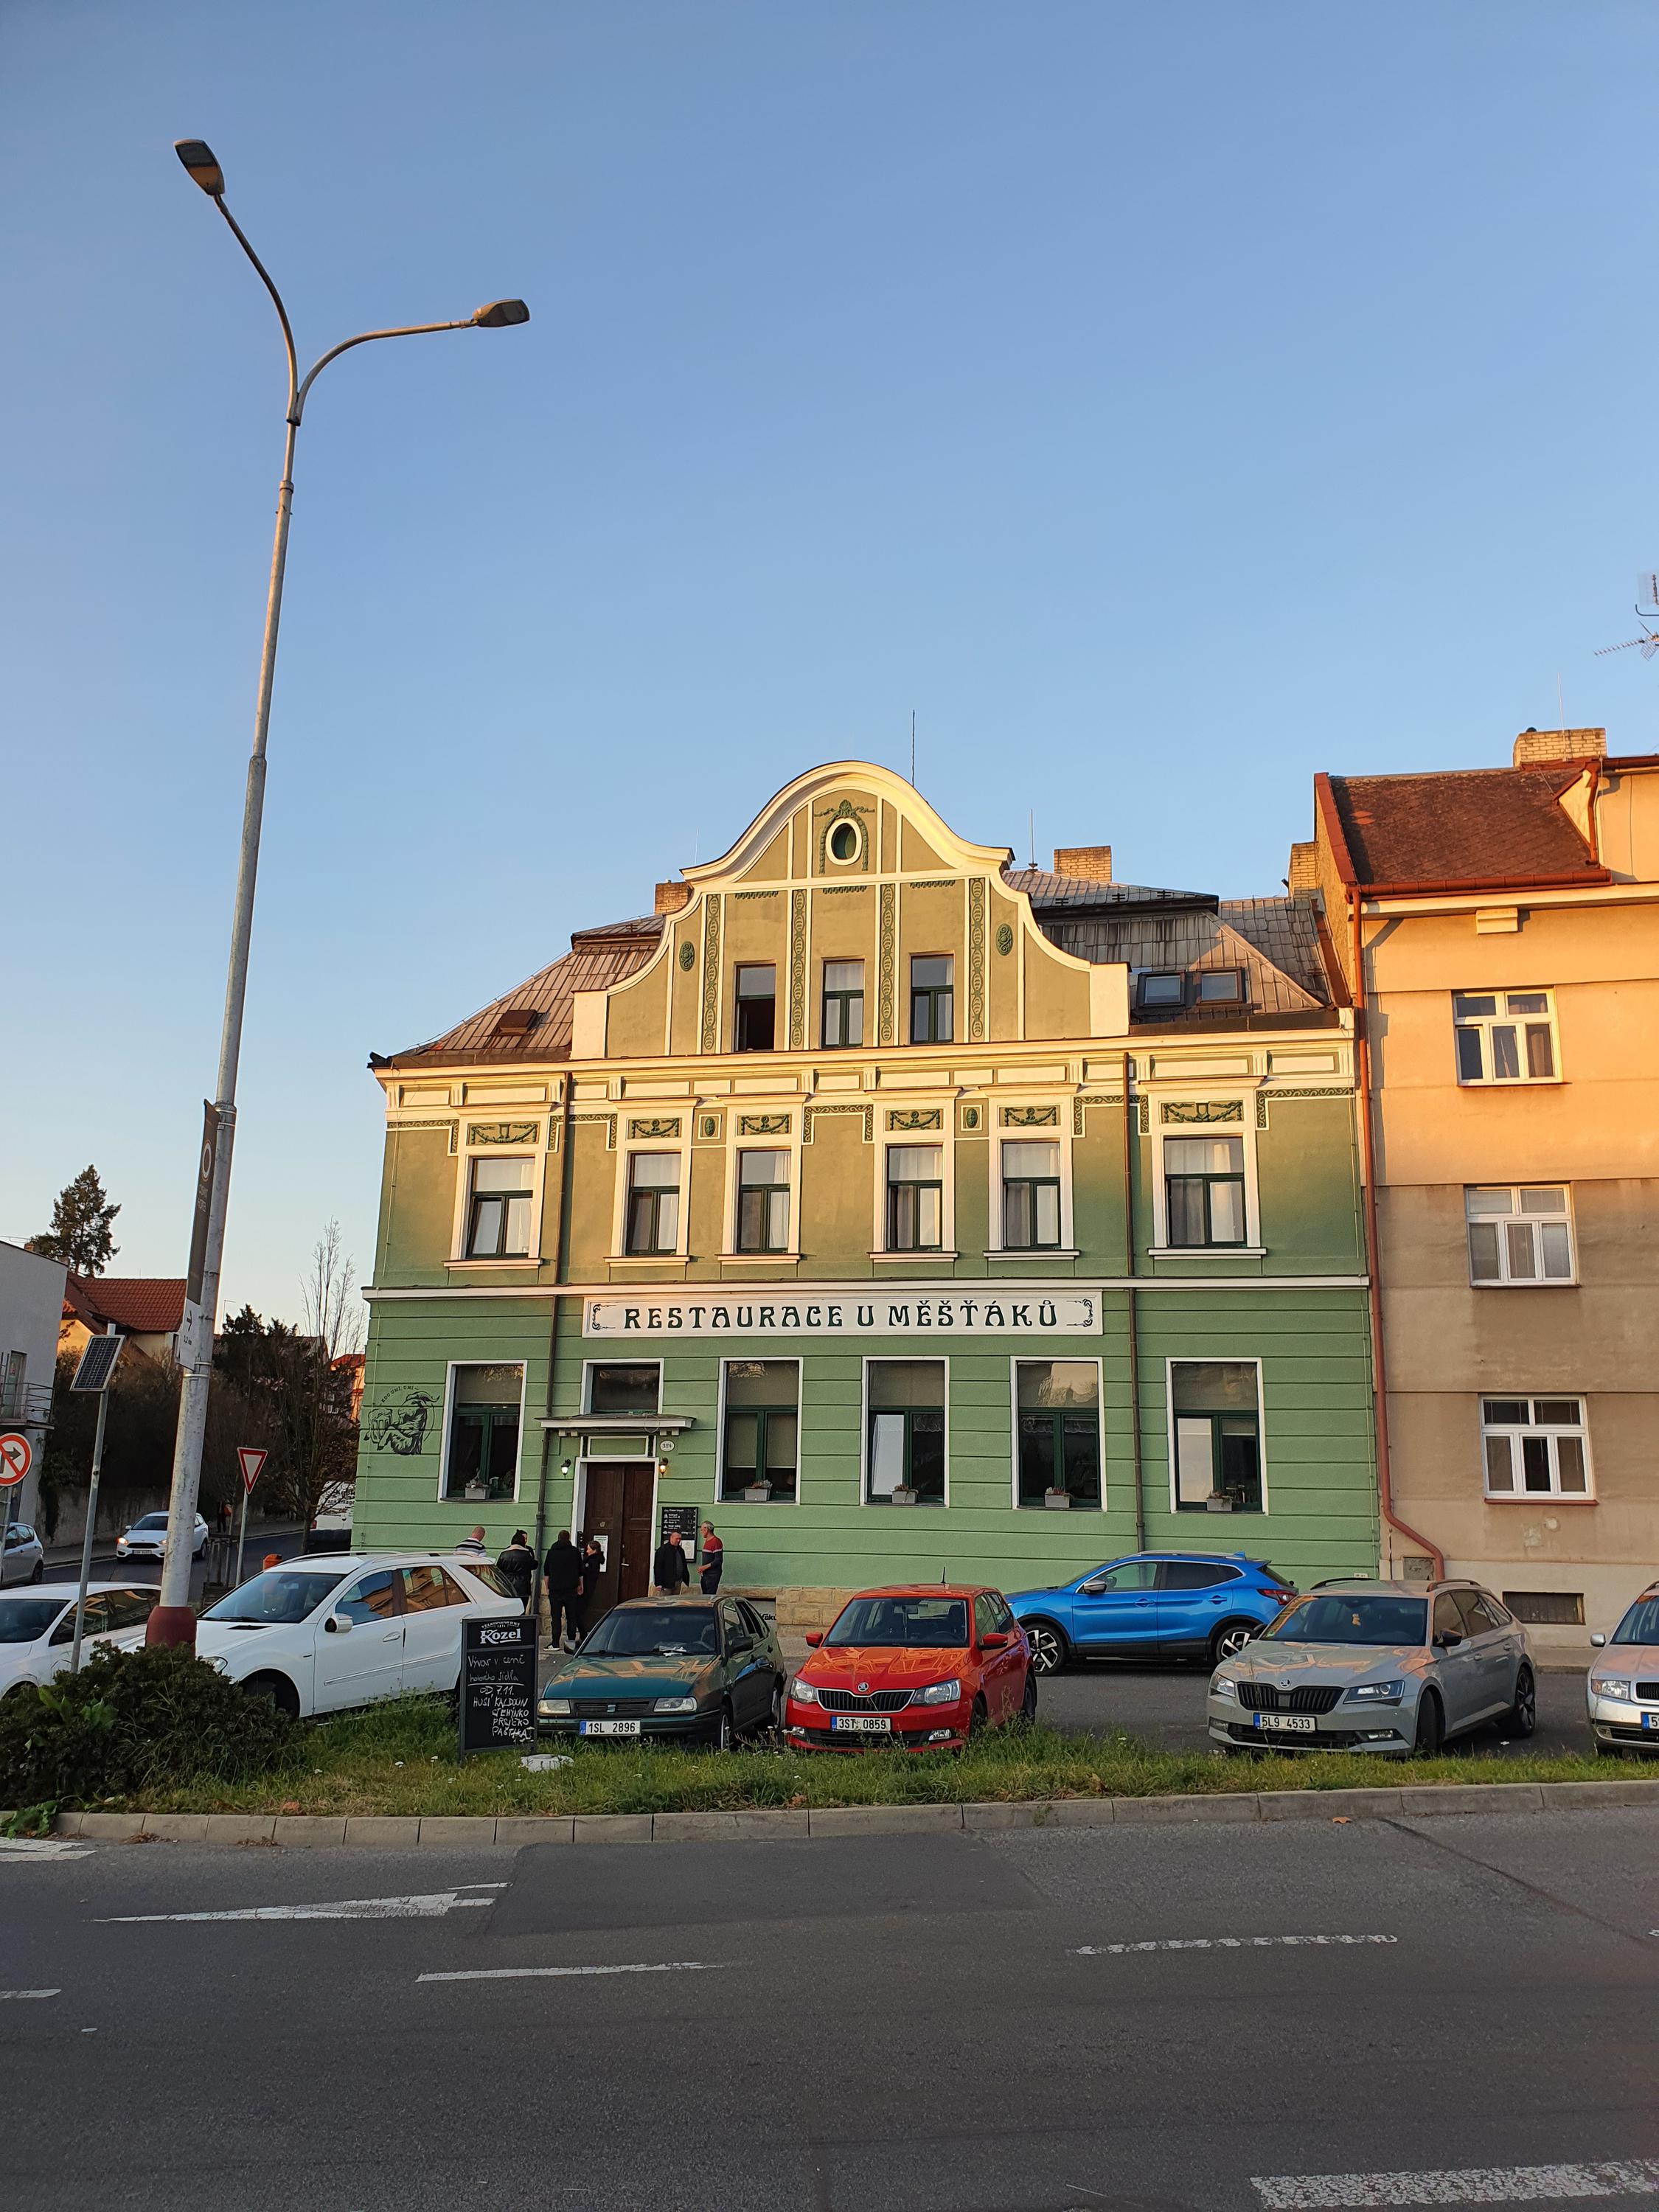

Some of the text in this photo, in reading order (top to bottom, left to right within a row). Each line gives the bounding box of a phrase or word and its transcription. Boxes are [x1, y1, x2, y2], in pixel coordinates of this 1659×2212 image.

[624, 1299, 1058, 1329] RESTAURACE U MĚŠŤÁKŮ
[480, 1628, 521, 1644] Kozel
[588, 1722, 636, 1733] 1SL 2896
[839, 1719, 886, 1730] 3ST 0859
[1262, 1717, 1310, 1729] 5L9 4533
